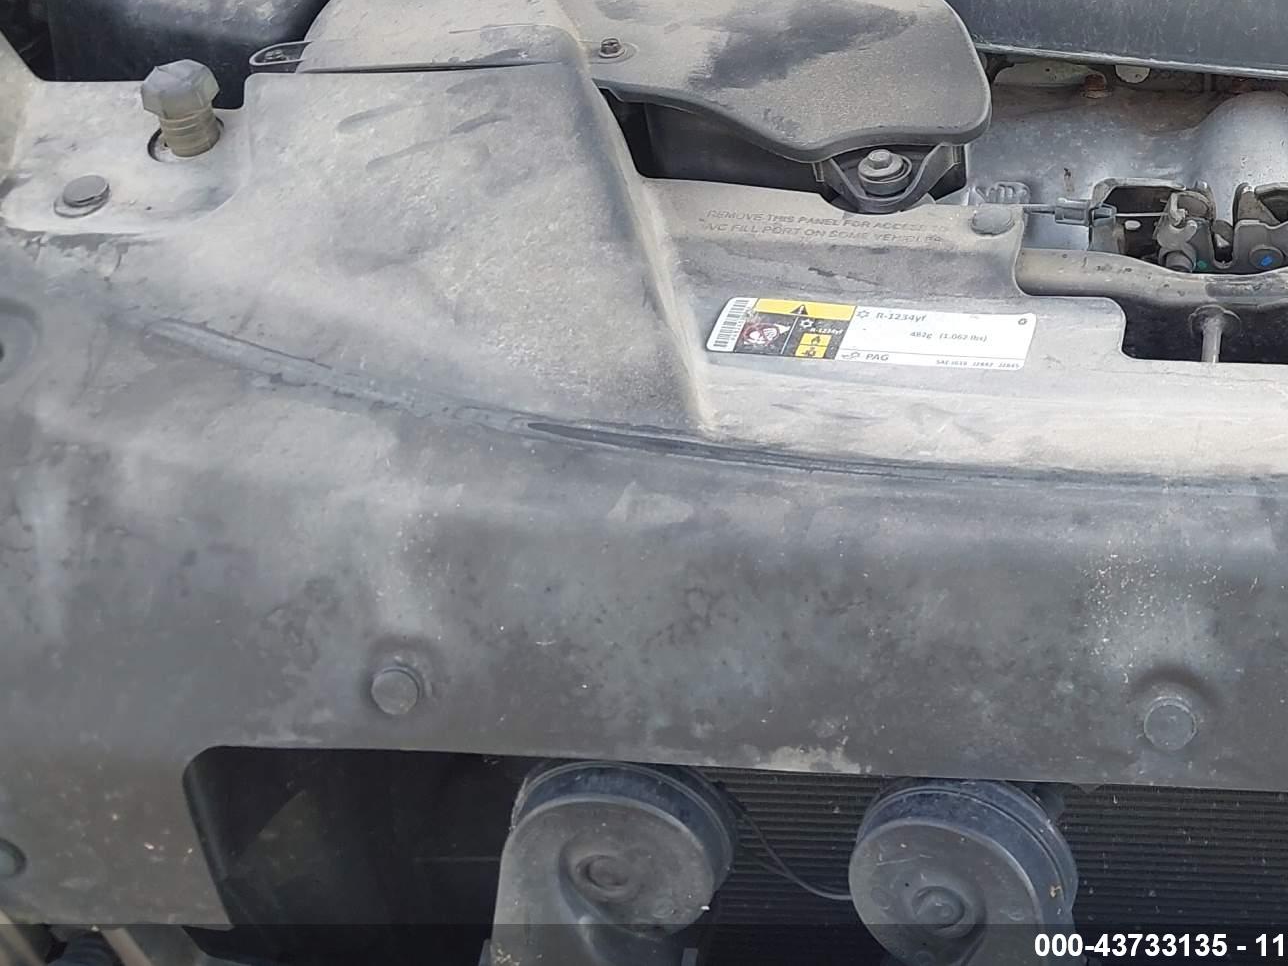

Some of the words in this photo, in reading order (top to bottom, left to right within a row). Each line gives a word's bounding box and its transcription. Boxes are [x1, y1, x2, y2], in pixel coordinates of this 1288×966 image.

[706, 209, 765, 222] REMOVE
[766, 212, 795, 224] THIS
[797, 215, 840, 227] PANEL
[842, 218, 870, 229] FOR
[729, 224, 759, 234] FILL
[760, 224, 801, 236] PORT
[803, 228, 826, 238] ON
[875, 311, 928, 323] R-1234yf
[865, 353, 889, 362] PAG
